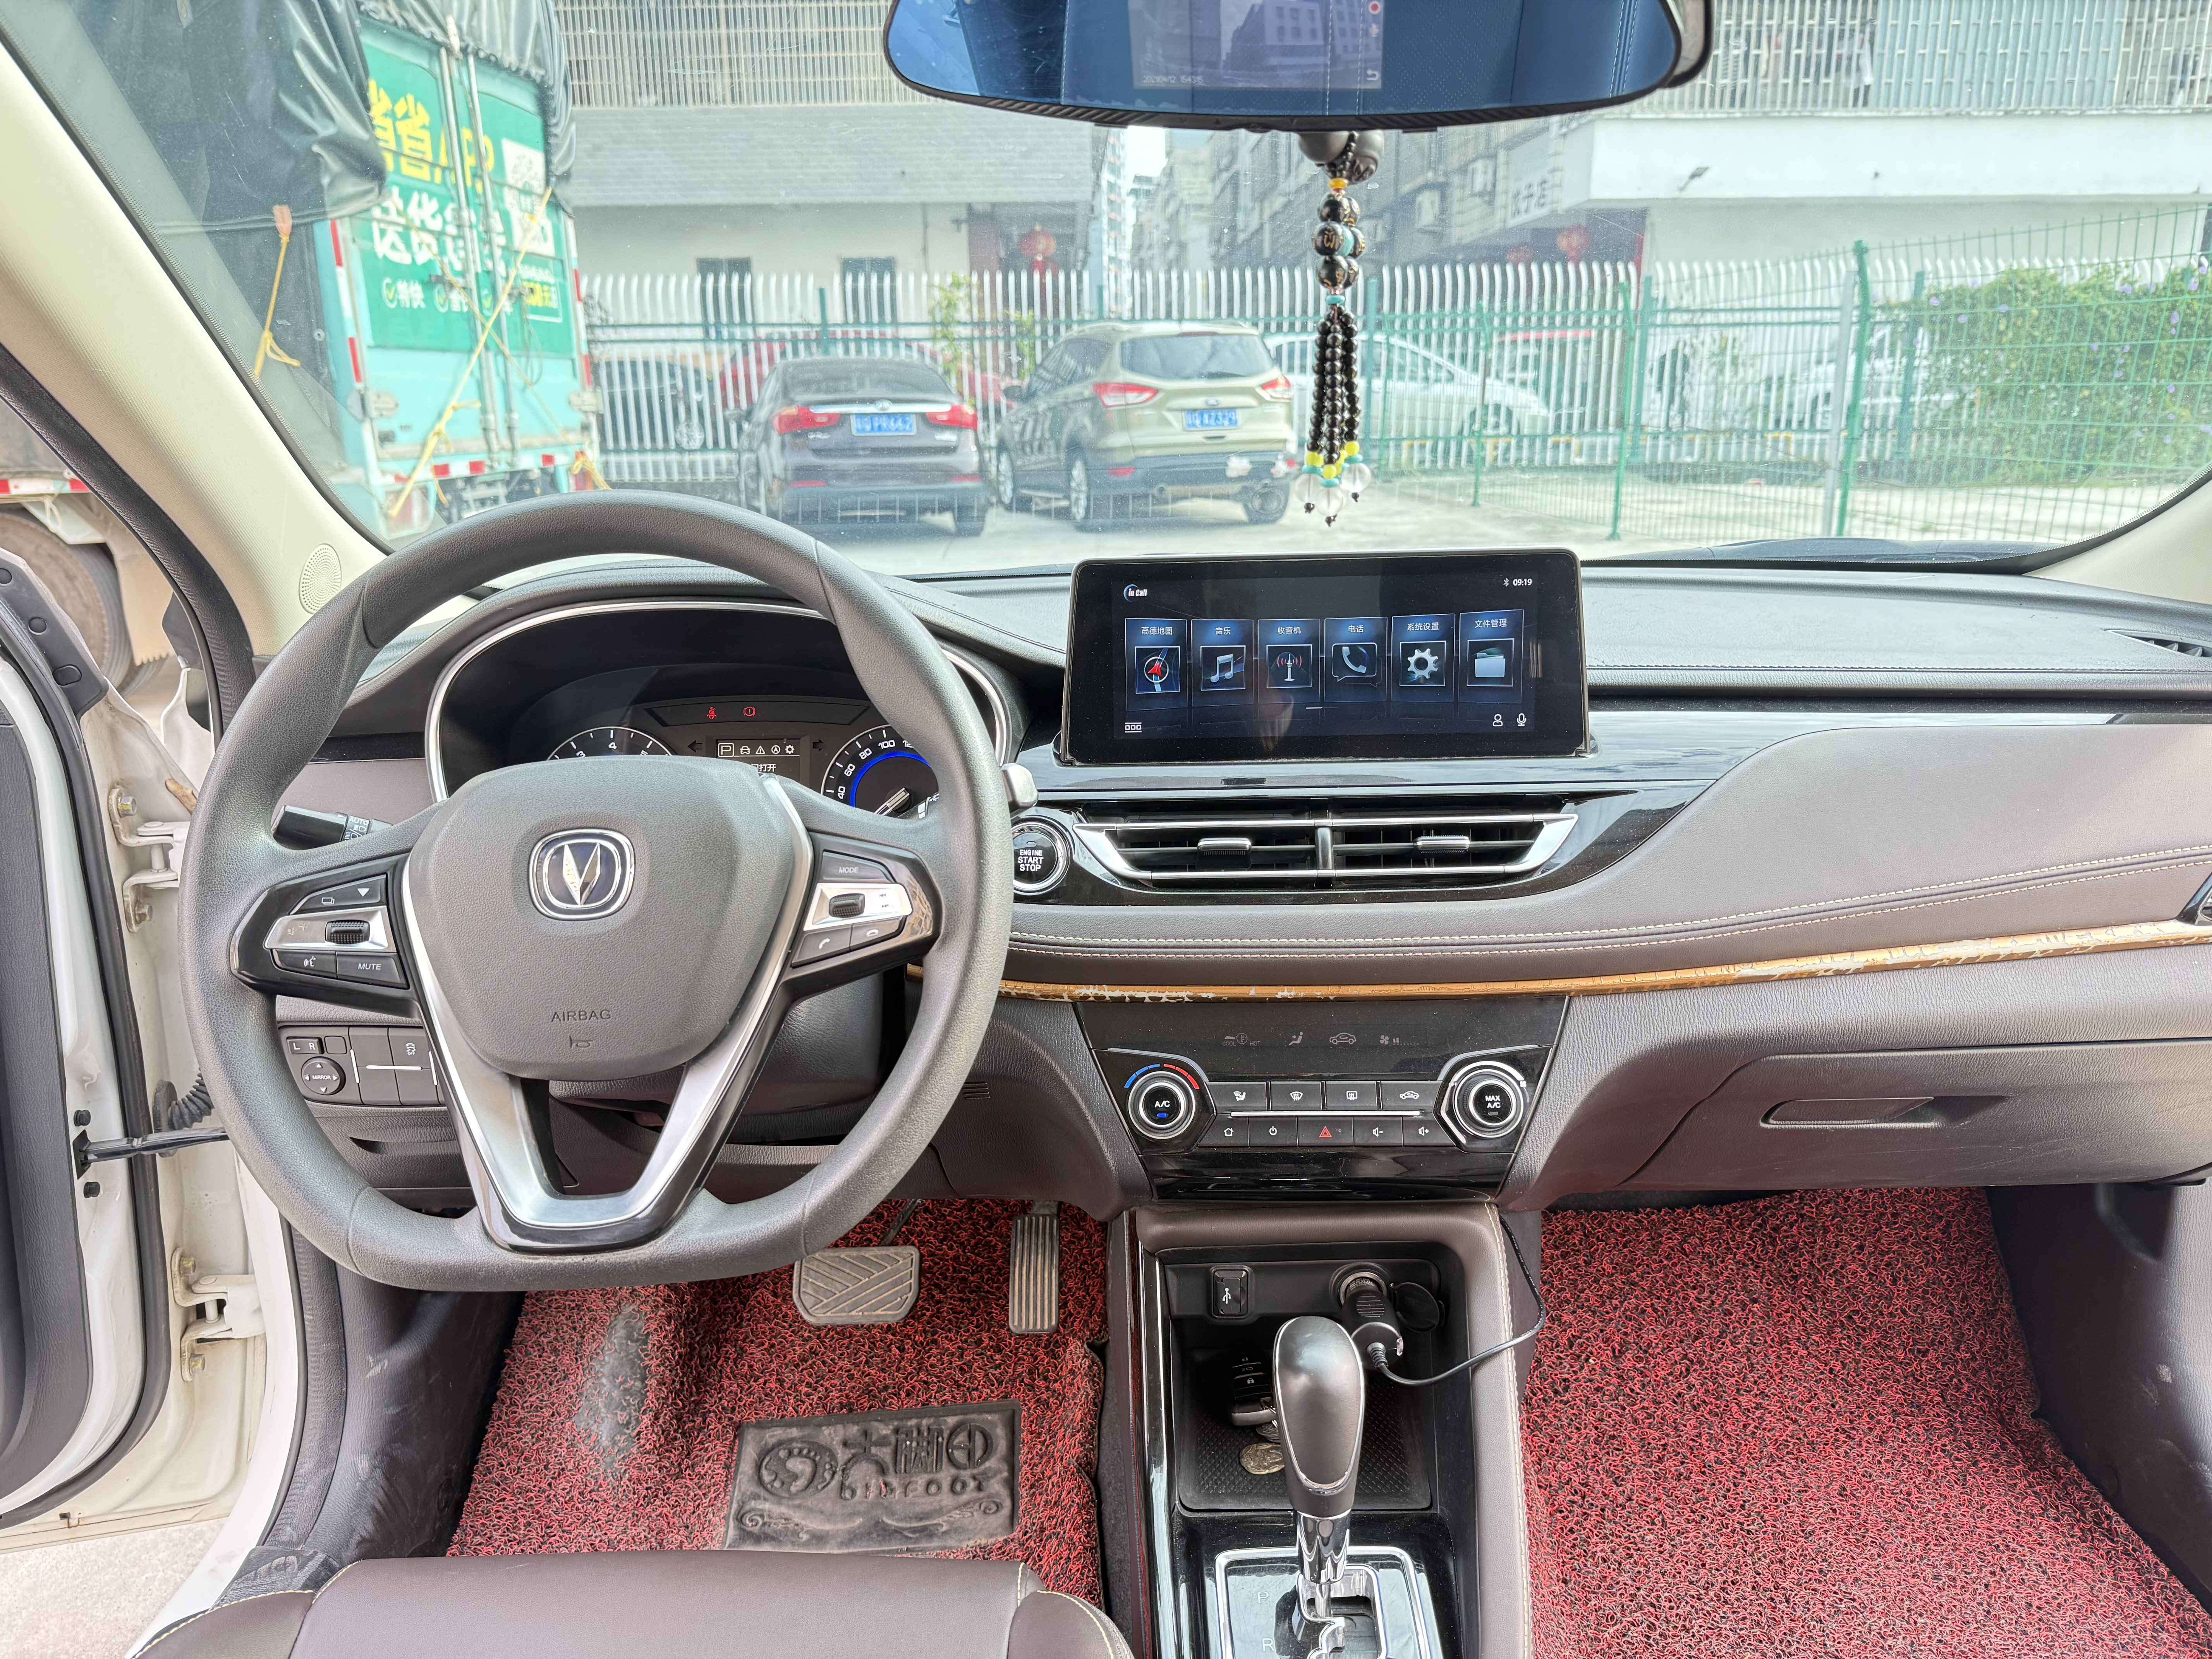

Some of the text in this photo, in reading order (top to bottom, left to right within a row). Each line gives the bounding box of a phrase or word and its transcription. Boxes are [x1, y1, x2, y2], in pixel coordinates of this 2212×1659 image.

[1135, 589, 1147, 597] Call
[1407, 622, 1439, 631] 系统设置
[1475, 618, 1508, 629] 文件管理
[1141, 627, 1173, 635] 高德地图
[1215, 627, 1231, 635] 音乐
[1278, 626, 1301, 635] 收音机
[1348, 625, 1364, 633] 电话
[878, 740, 896, 749] 100
[721, 745, 732, 755] P
[859, 748, 872, 760] 80
[844, 763, 855, 776] 60
[837, 786, 846, 799] 40
[350, 817, 369, 825] AUTO
[551, 1009, 611, 1022] AIRBAG
[1257, 1591, 1269, 1604] P
[1262, 1638, 1274, 1652] R
